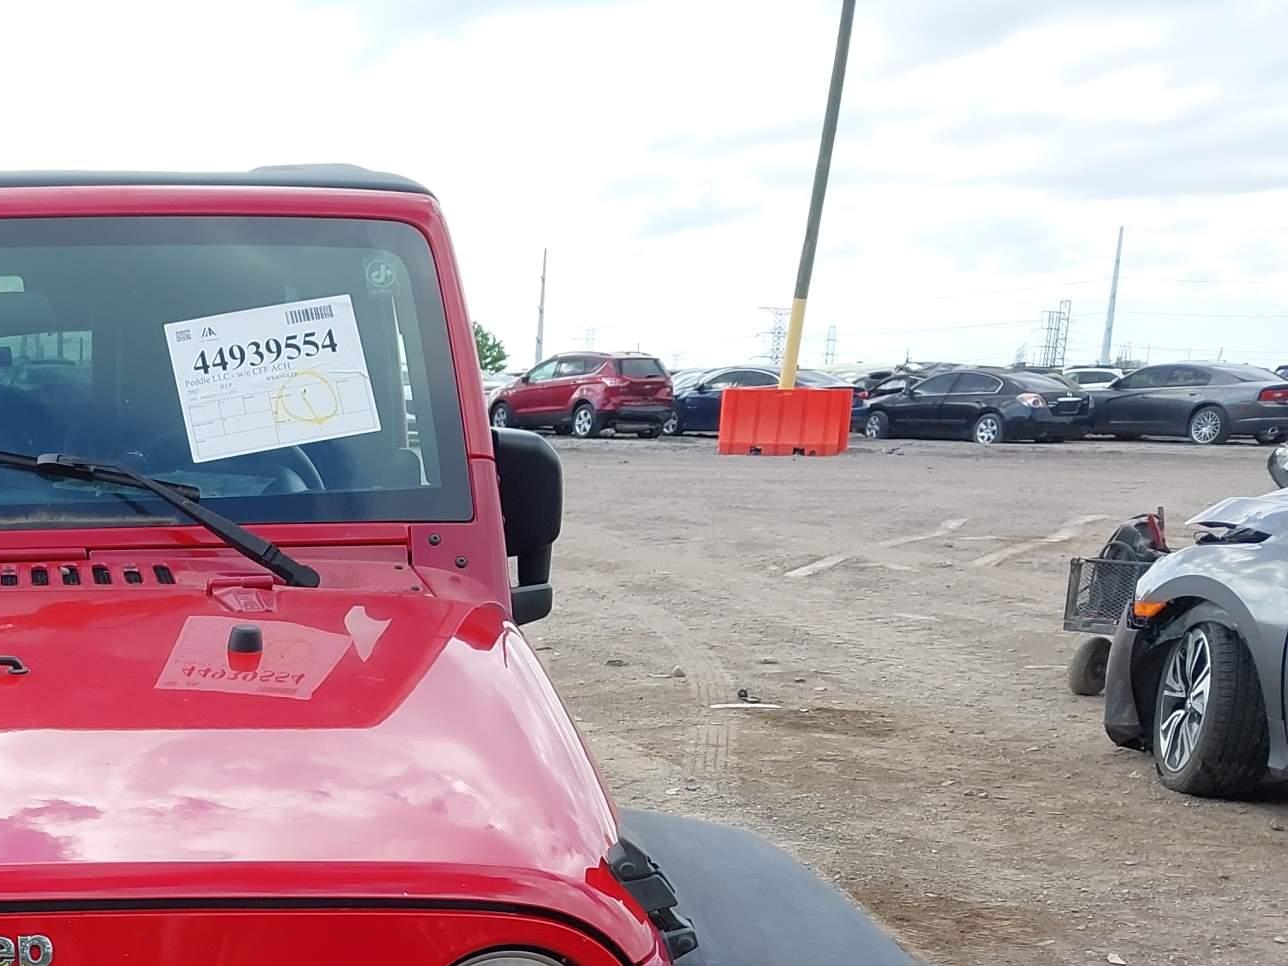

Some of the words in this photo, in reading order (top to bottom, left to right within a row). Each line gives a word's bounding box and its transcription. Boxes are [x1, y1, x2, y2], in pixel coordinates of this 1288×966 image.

[193, 328, 338, 374] 44939554
[184, 376, 210, 387] Peddle
[212, 372, 229, 383] LLC
